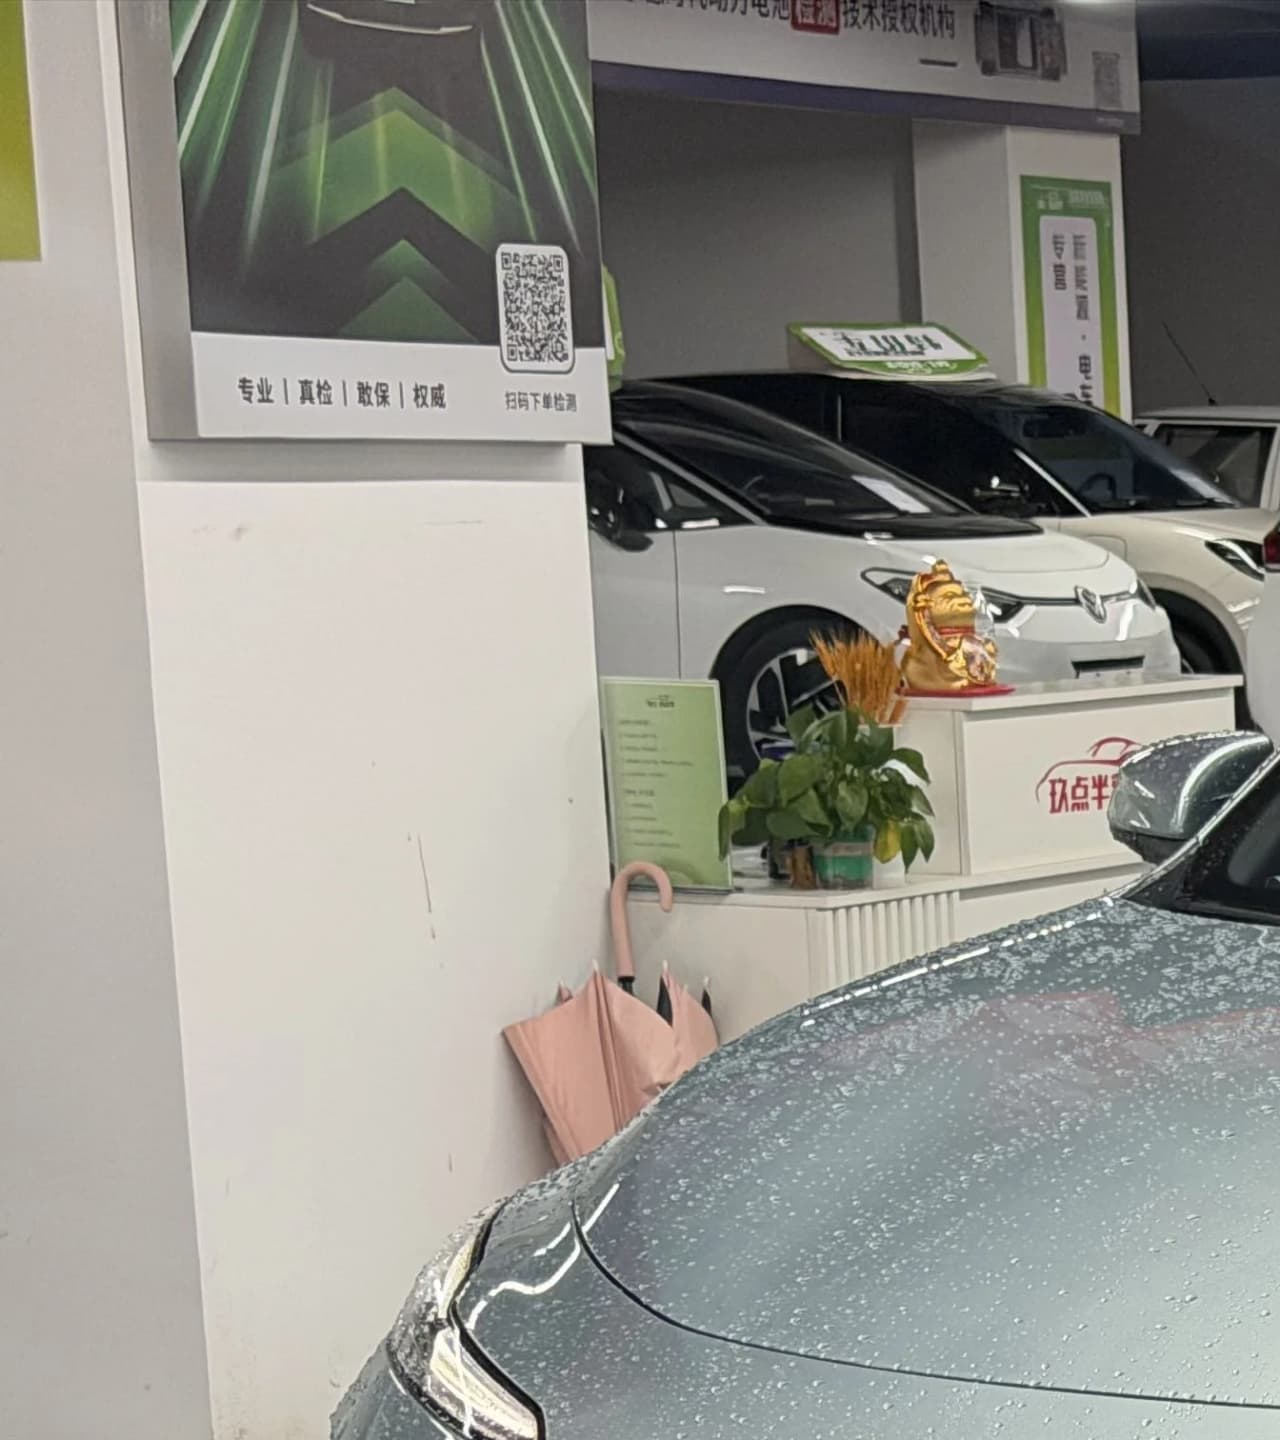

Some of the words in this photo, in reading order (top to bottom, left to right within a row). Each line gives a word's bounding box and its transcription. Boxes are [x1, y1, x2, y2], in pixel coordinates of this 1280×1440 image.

[238, 377, 274, 404] 专业
[298, 379, 333, 405] 真检
[357, 381, 391, 408] 敢保
[413, 383, 446, 409] 权威
[1048, 773, 1120, 815] 玖点半
